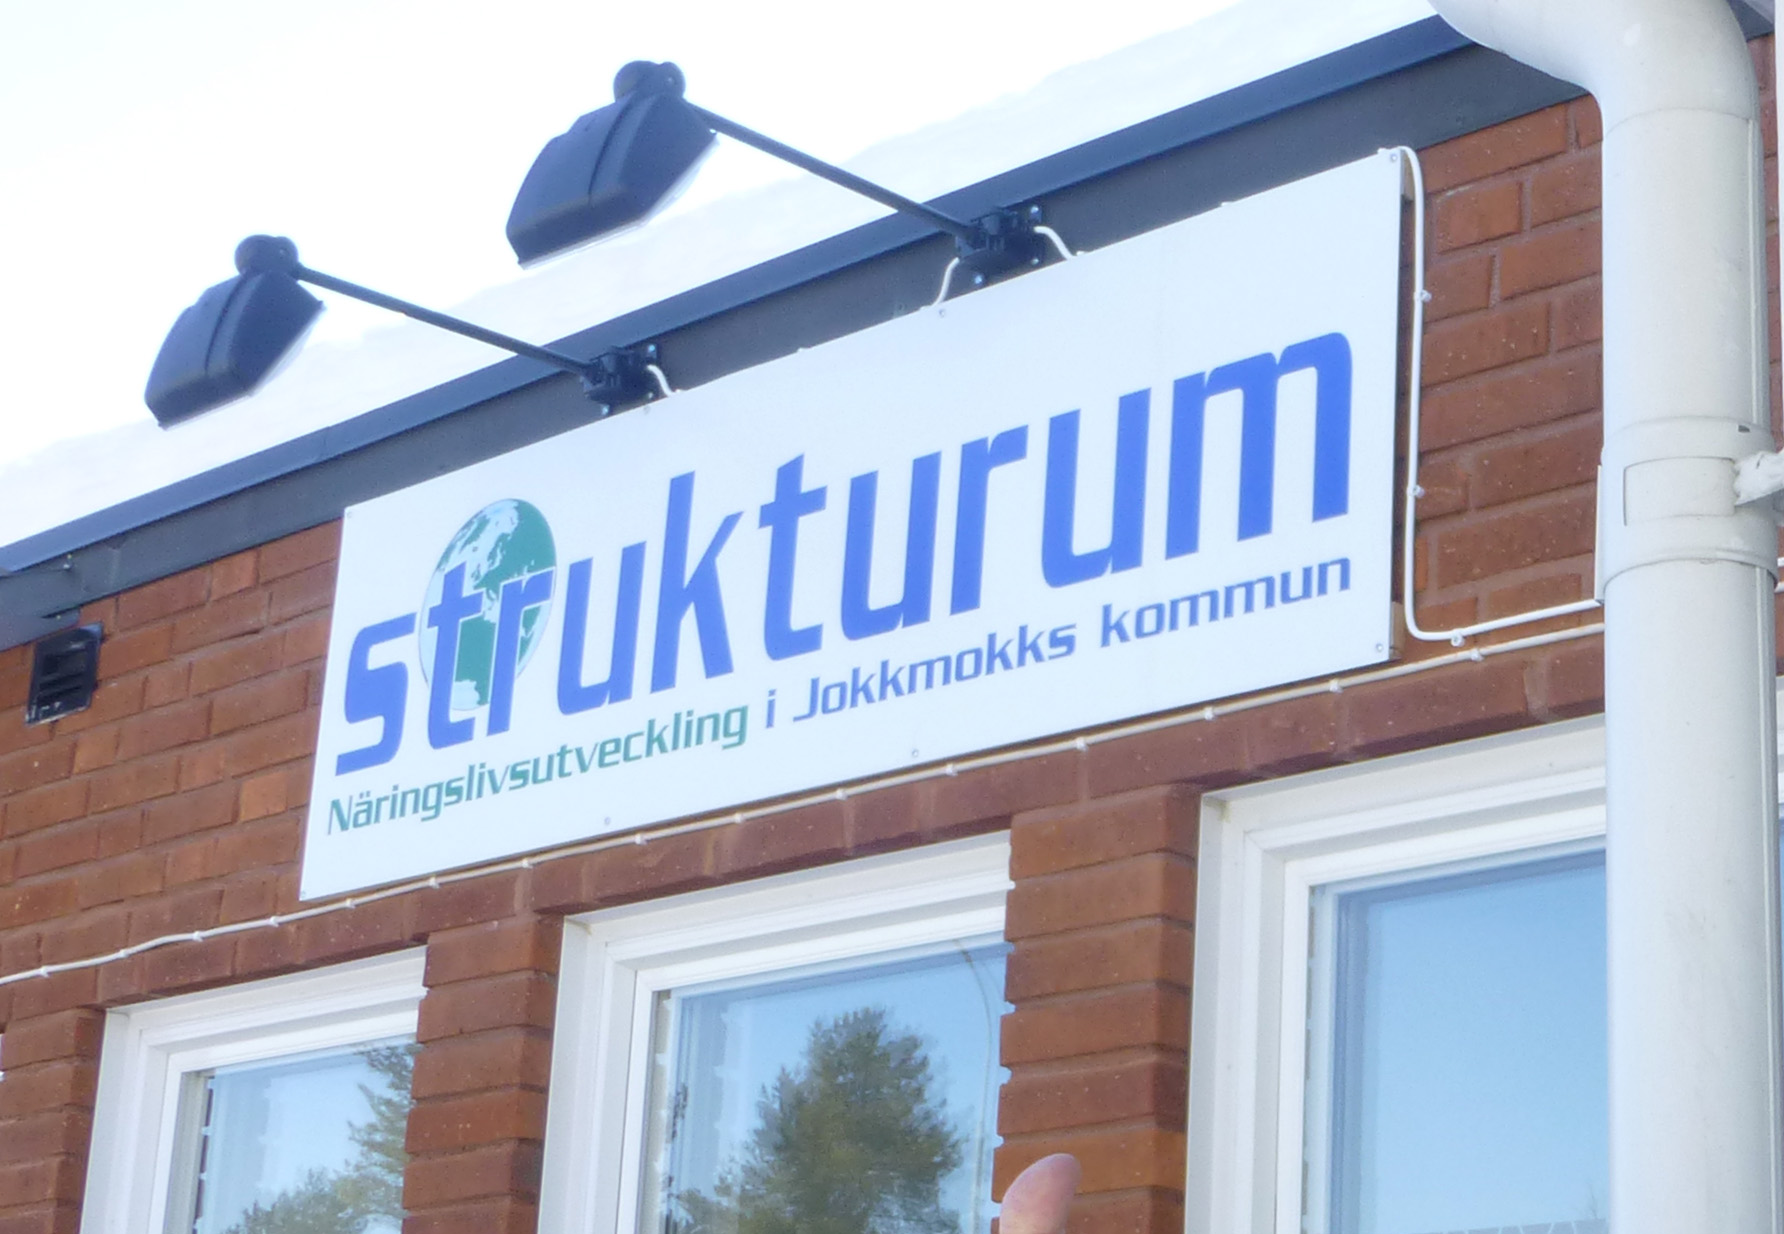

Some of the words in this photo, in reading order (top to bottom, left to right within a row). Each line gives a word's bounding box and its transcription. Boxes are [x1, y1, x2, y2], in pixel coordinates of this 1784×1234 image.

[327, 705, 750, 835] Näringslivsutveckling
[764, 689, 777, 729] i
[792, 622, 1077, 722] Jokkmokks
[1100, 557, 1352, 648] kommun
[335, 332, 1353, 777] strukturum
